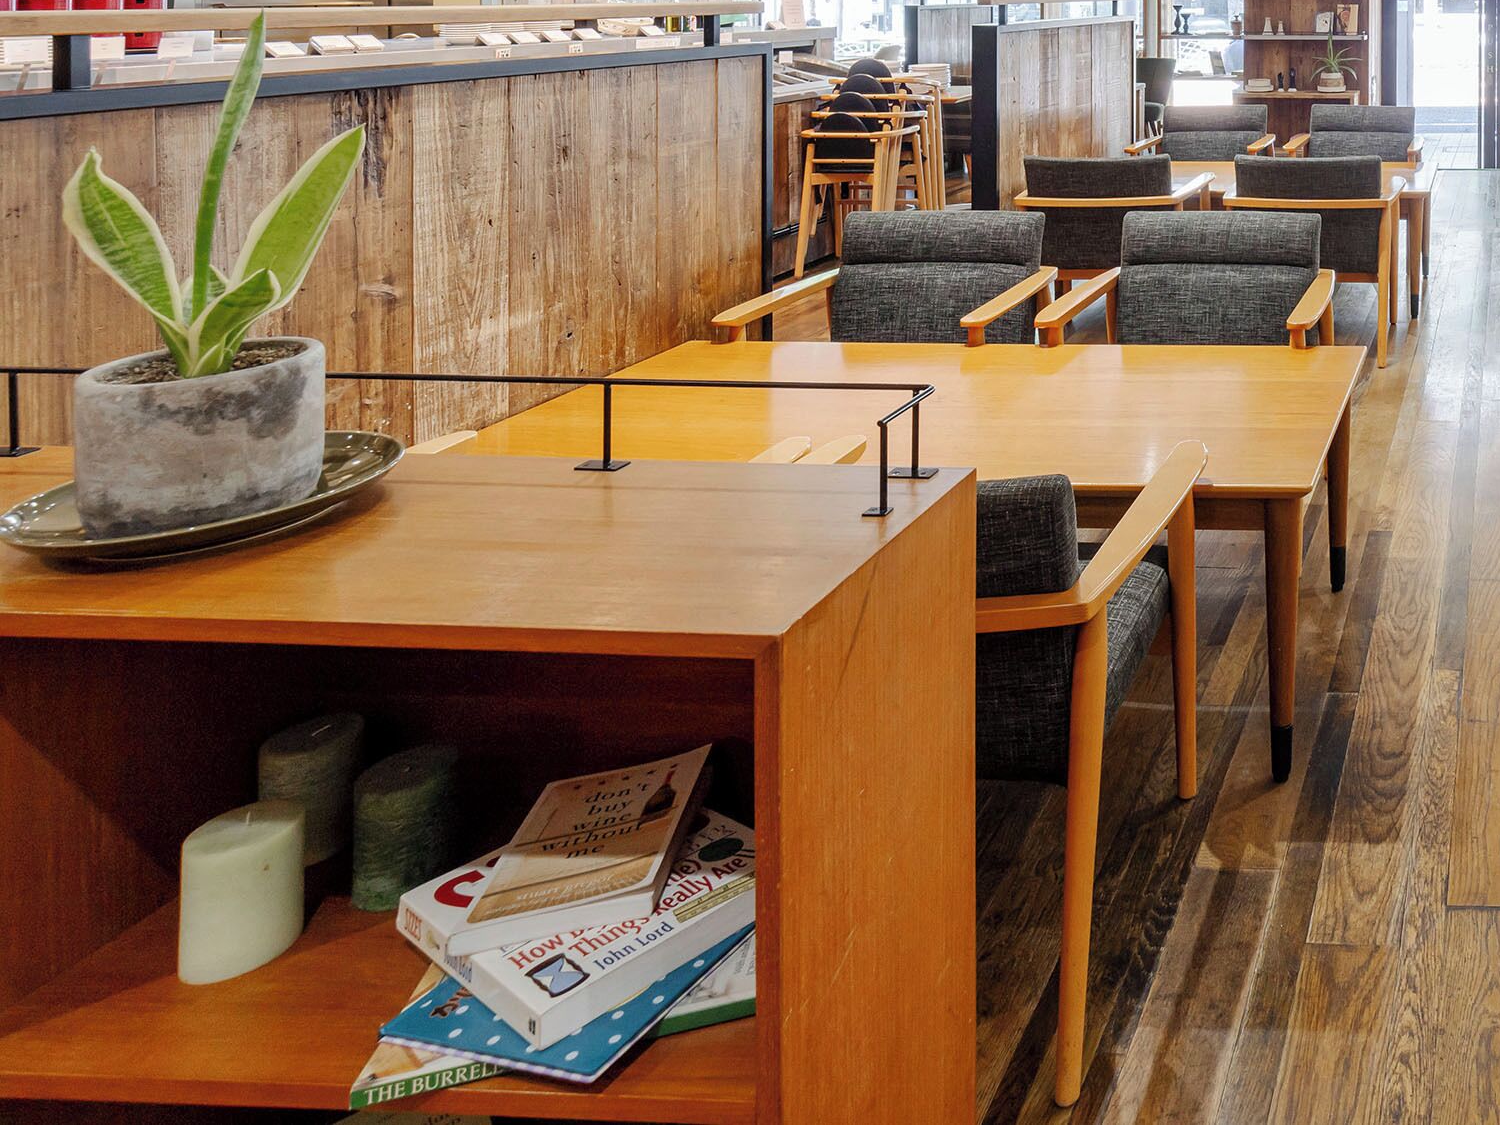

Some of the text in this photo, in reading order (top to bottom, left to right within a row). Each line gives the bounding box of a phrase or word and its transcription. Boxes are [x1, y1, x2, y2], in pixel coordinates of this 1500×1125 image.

[585, 782, 648, 803] don't
[587, 799, 634, 816] buy
[573, 813, 632, 831] wine
[541, 821, 642, 851] without
[565, 844, 605, 859] me
[568, 916, 651, 959] Things
[711, 857, 748, 880] Are
[508, 934, 565, 970] How
[592, 941, 638, 971] John
[638, 921, 675, 948] Lord
[364, 1081, 406, 1106] THE
